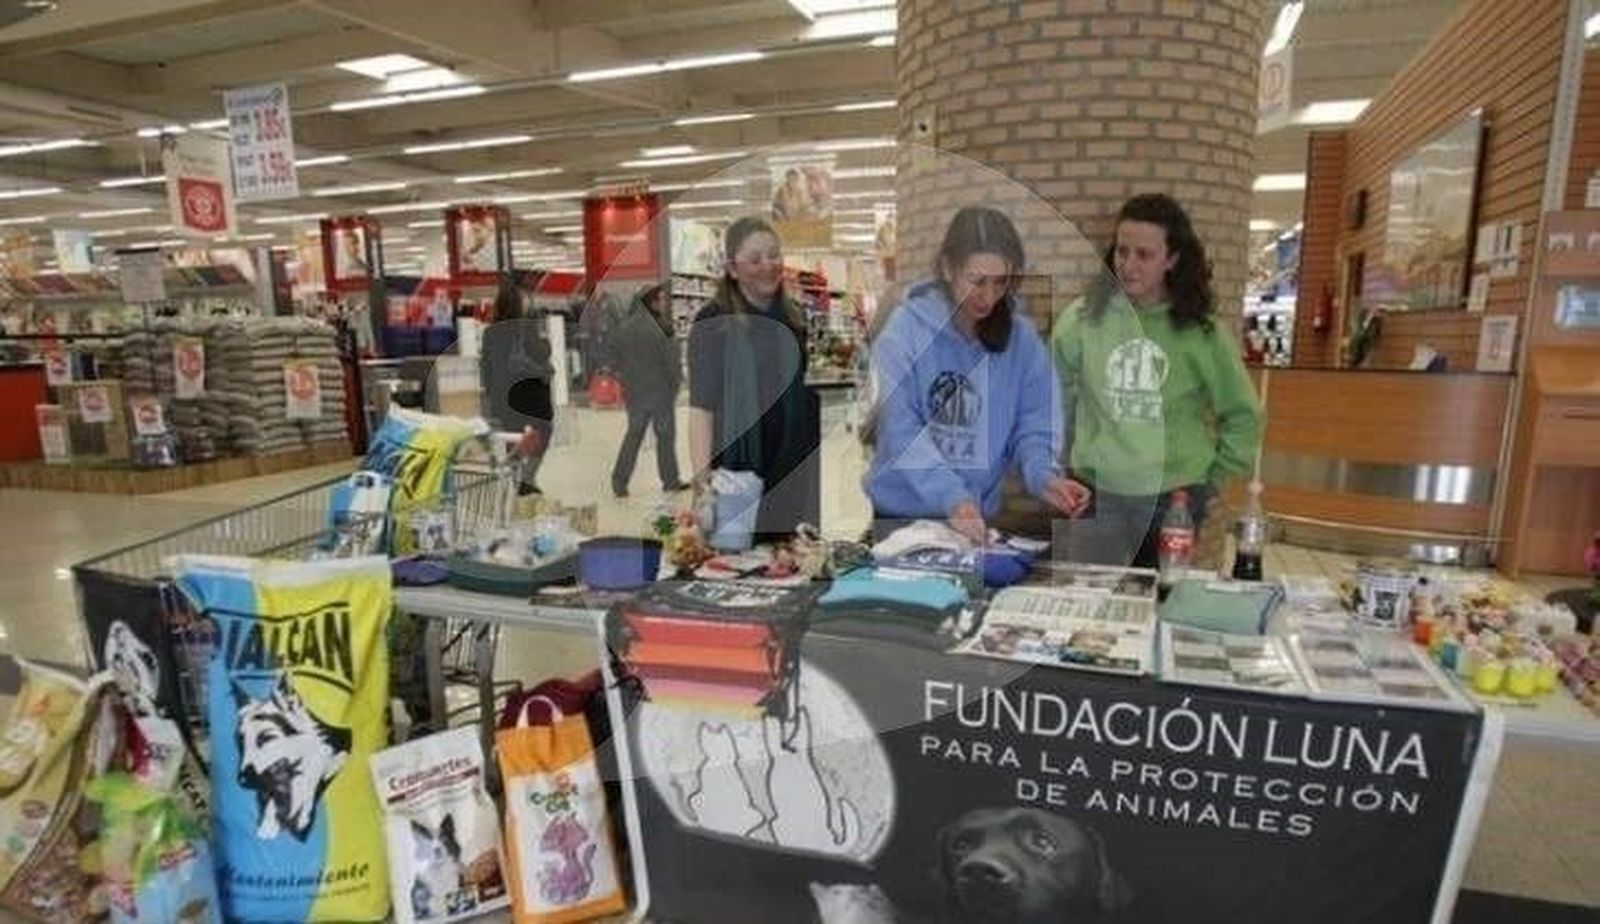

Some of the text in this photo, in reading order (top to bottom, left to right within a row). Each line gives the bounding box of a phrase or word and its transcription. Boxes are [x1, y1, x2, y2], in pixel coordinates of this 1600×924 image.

[923, 679, 1429, 778] FUNDACIÓN LUNA
[920, 736, 1420, 814] PARA LA PROTECCIÓN
[1016, 777, 1314, 836] DE ANIMALES
